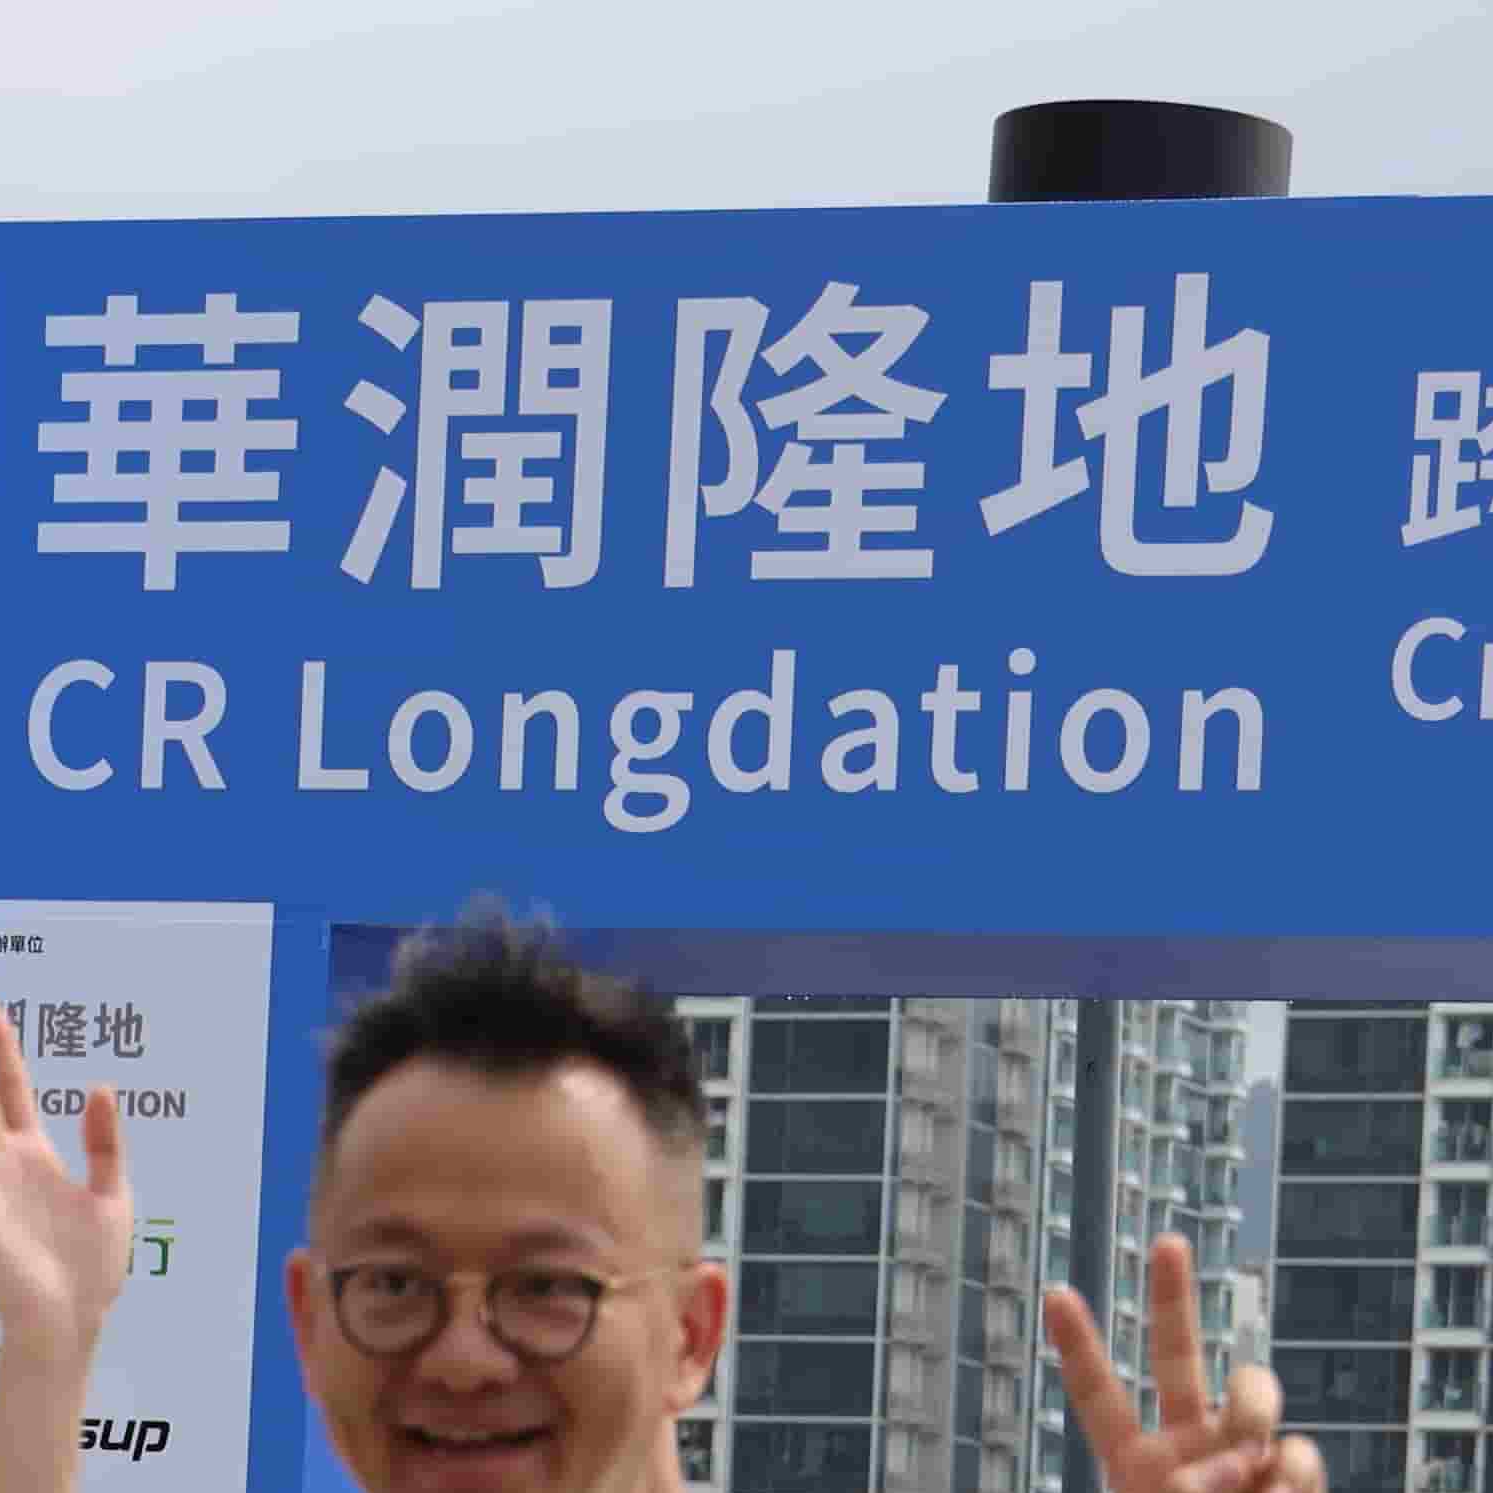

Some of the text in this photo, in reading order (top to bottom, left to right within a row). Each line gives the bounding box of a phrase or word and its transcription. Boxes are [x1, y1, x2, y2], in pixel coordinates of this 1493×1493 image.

[36, 272, 1276, 592] 華潤隆地
[26, 646, 1265, 834] CR Longdation
